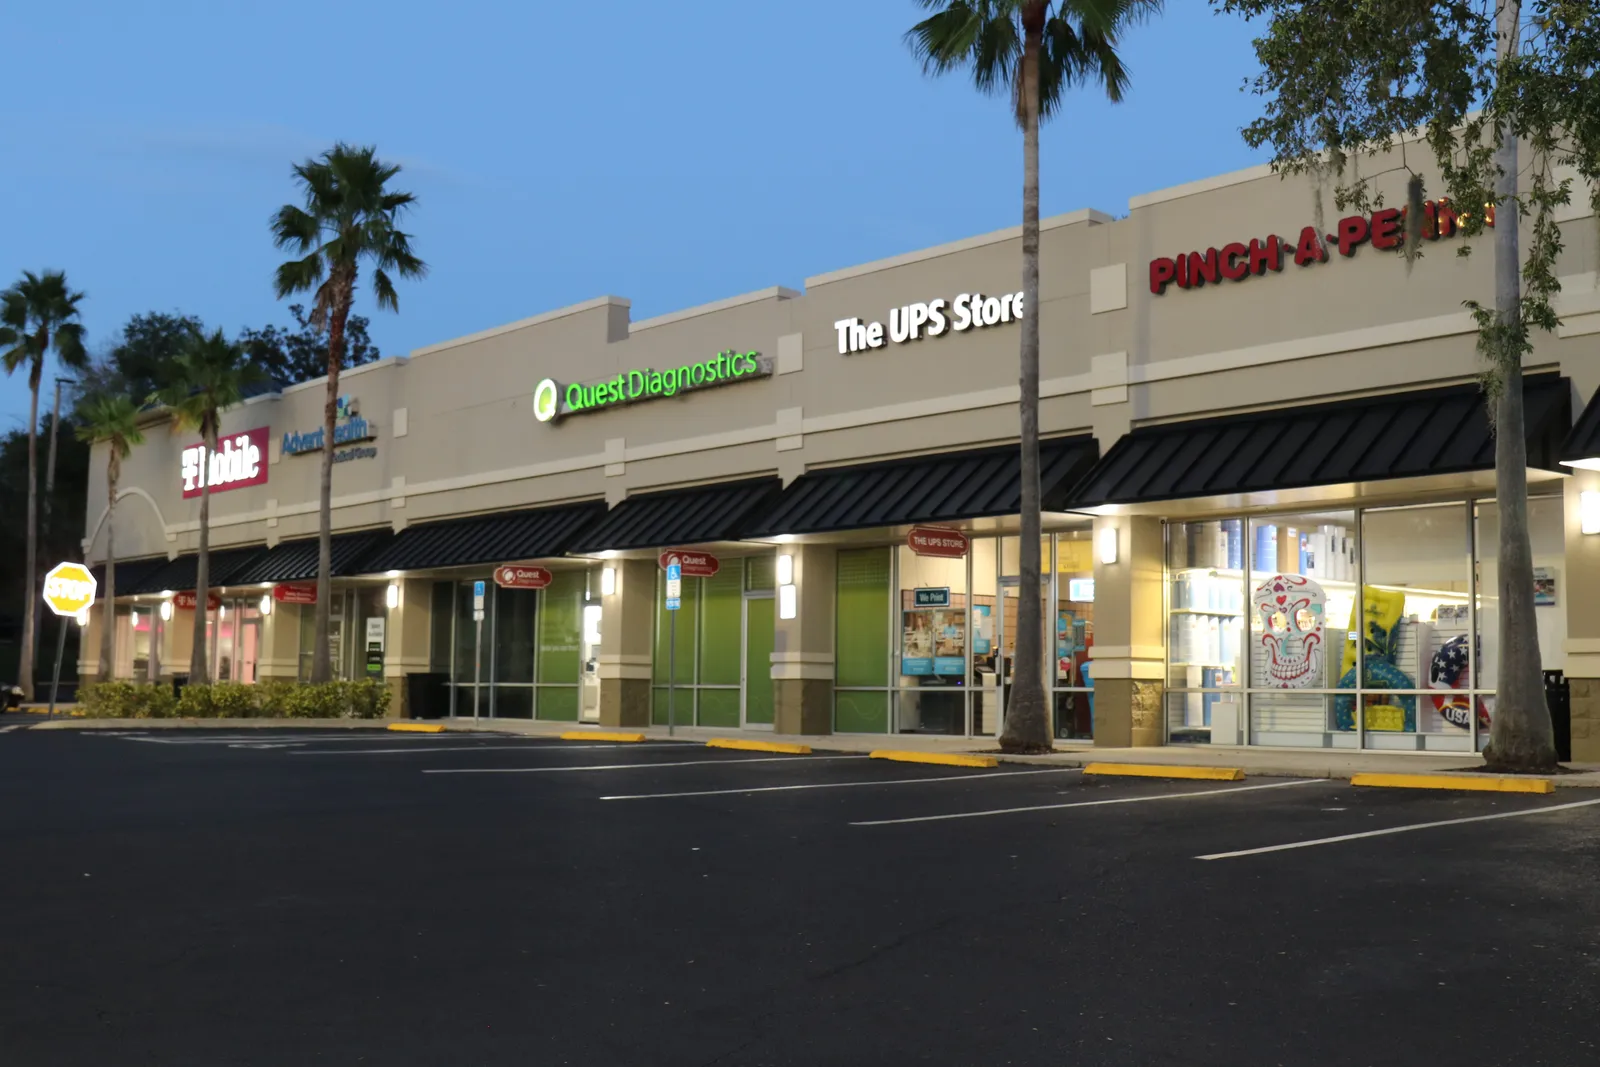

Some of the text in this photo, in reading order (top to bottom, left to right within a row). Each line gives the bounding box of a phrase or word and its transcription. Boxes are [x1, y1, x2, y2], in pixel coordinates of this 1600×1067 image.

[1150, 196, 1496, 294] PINCH-A-PEN
[834, 291, 1024, 354] The UPS Store
[566, 349, 758, 411] Quest Diagnostics
[281, 416, 368, 454] Adventealth
[914, 536, 964, 548] THE UPS STORE
[682, 554, 707, 565] Quest
[516, 569, 540, 579] Quest
[48, 577, 91, 601] STOP
[919, 592, 944, 602] We Print
[1445, 708, 1470, 724] USA
